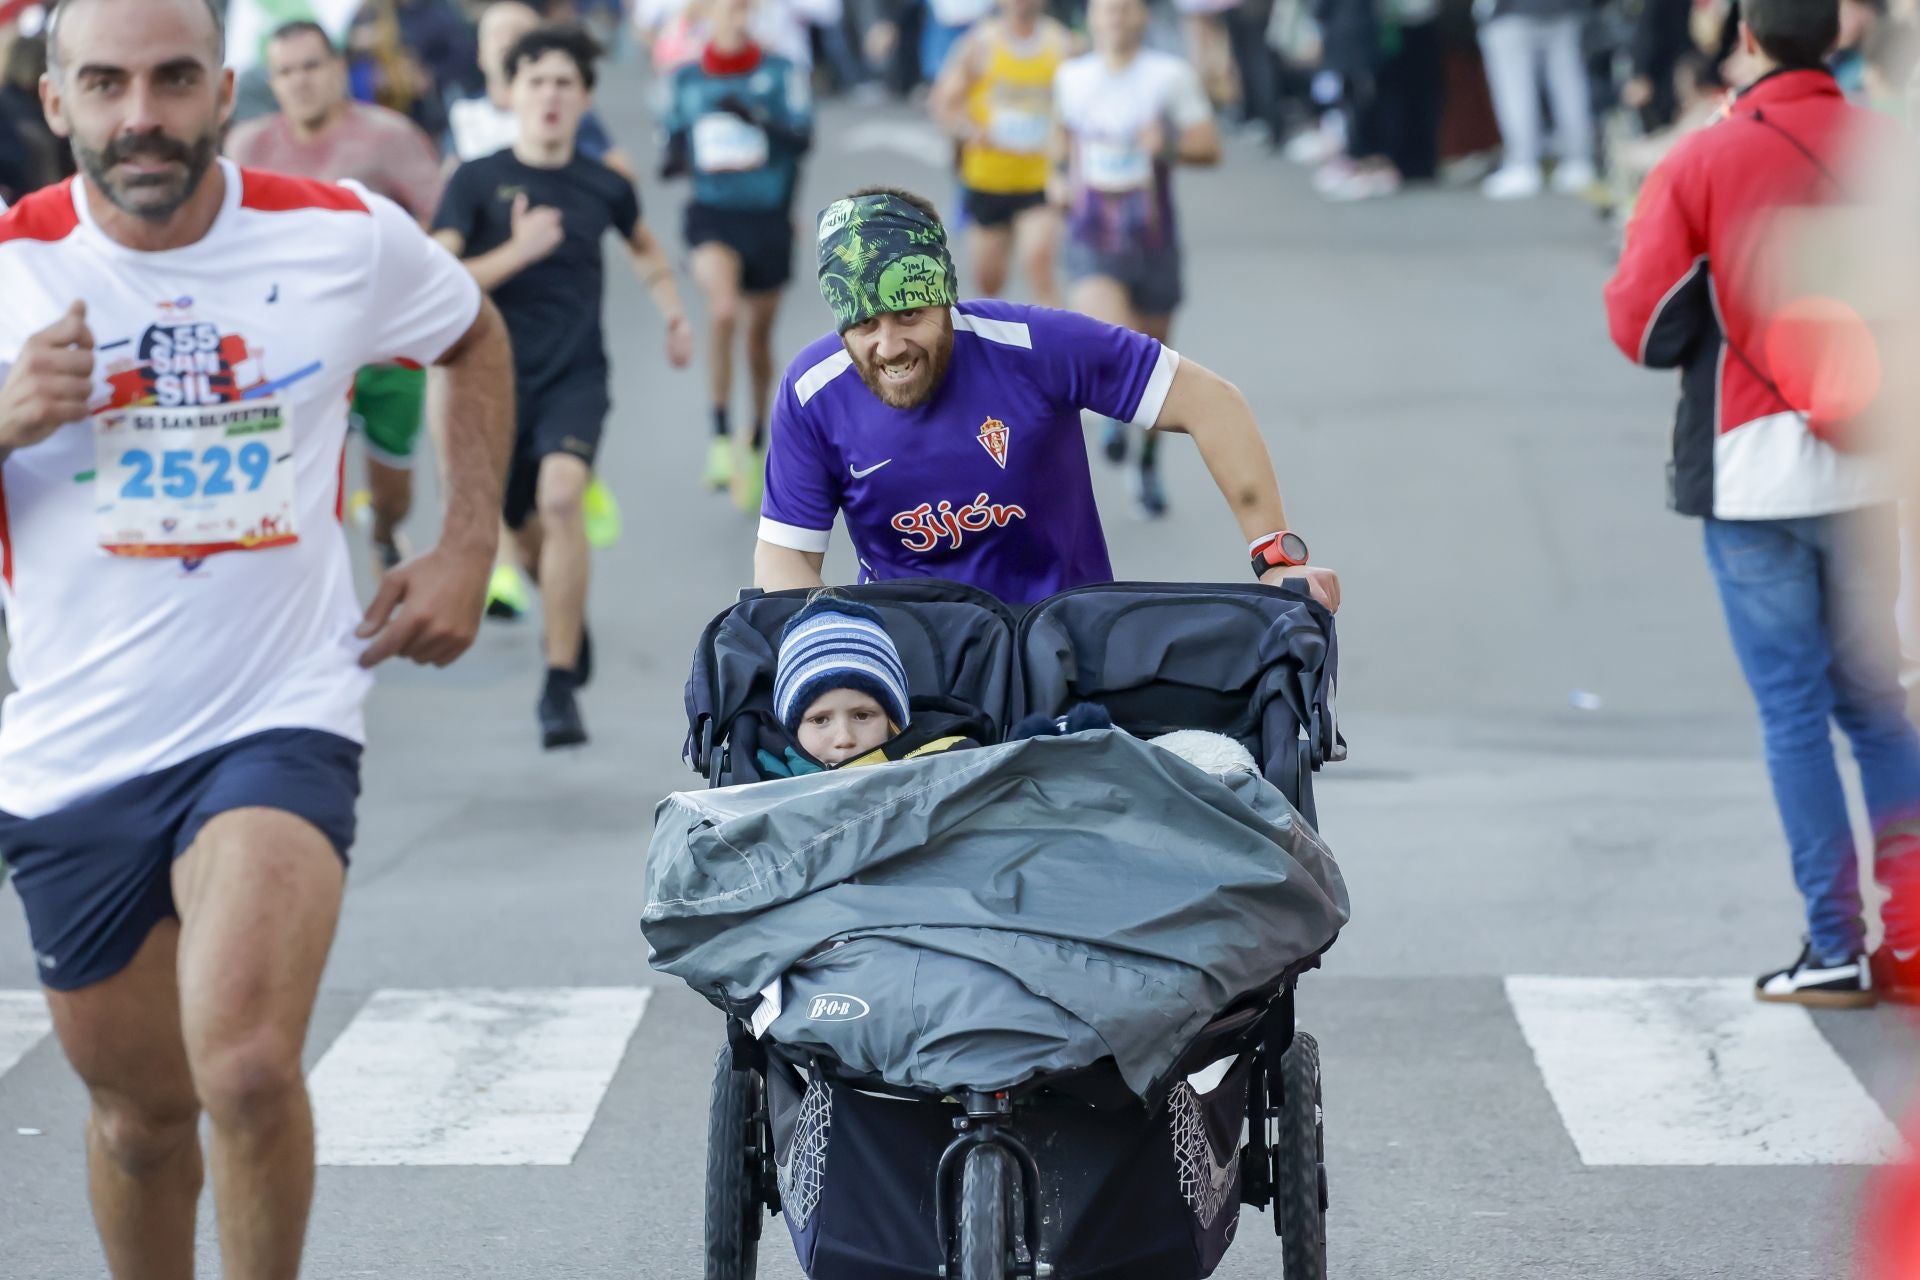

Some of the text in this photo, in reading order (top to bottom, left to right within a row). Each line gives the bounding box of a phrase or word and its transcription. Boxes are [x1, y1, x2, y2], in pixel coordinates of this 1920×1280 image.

[900, 270, 936, 286] Power
[901, 259, 931, 274] Tools
[888, 285, 946, 307] Hitachi
[150, 344, 221, 375] SAN
[155, 373, 222, 407] SIL
[119, 441, 271, 498] 2529
[891, 492, 1026, 552] gijón
